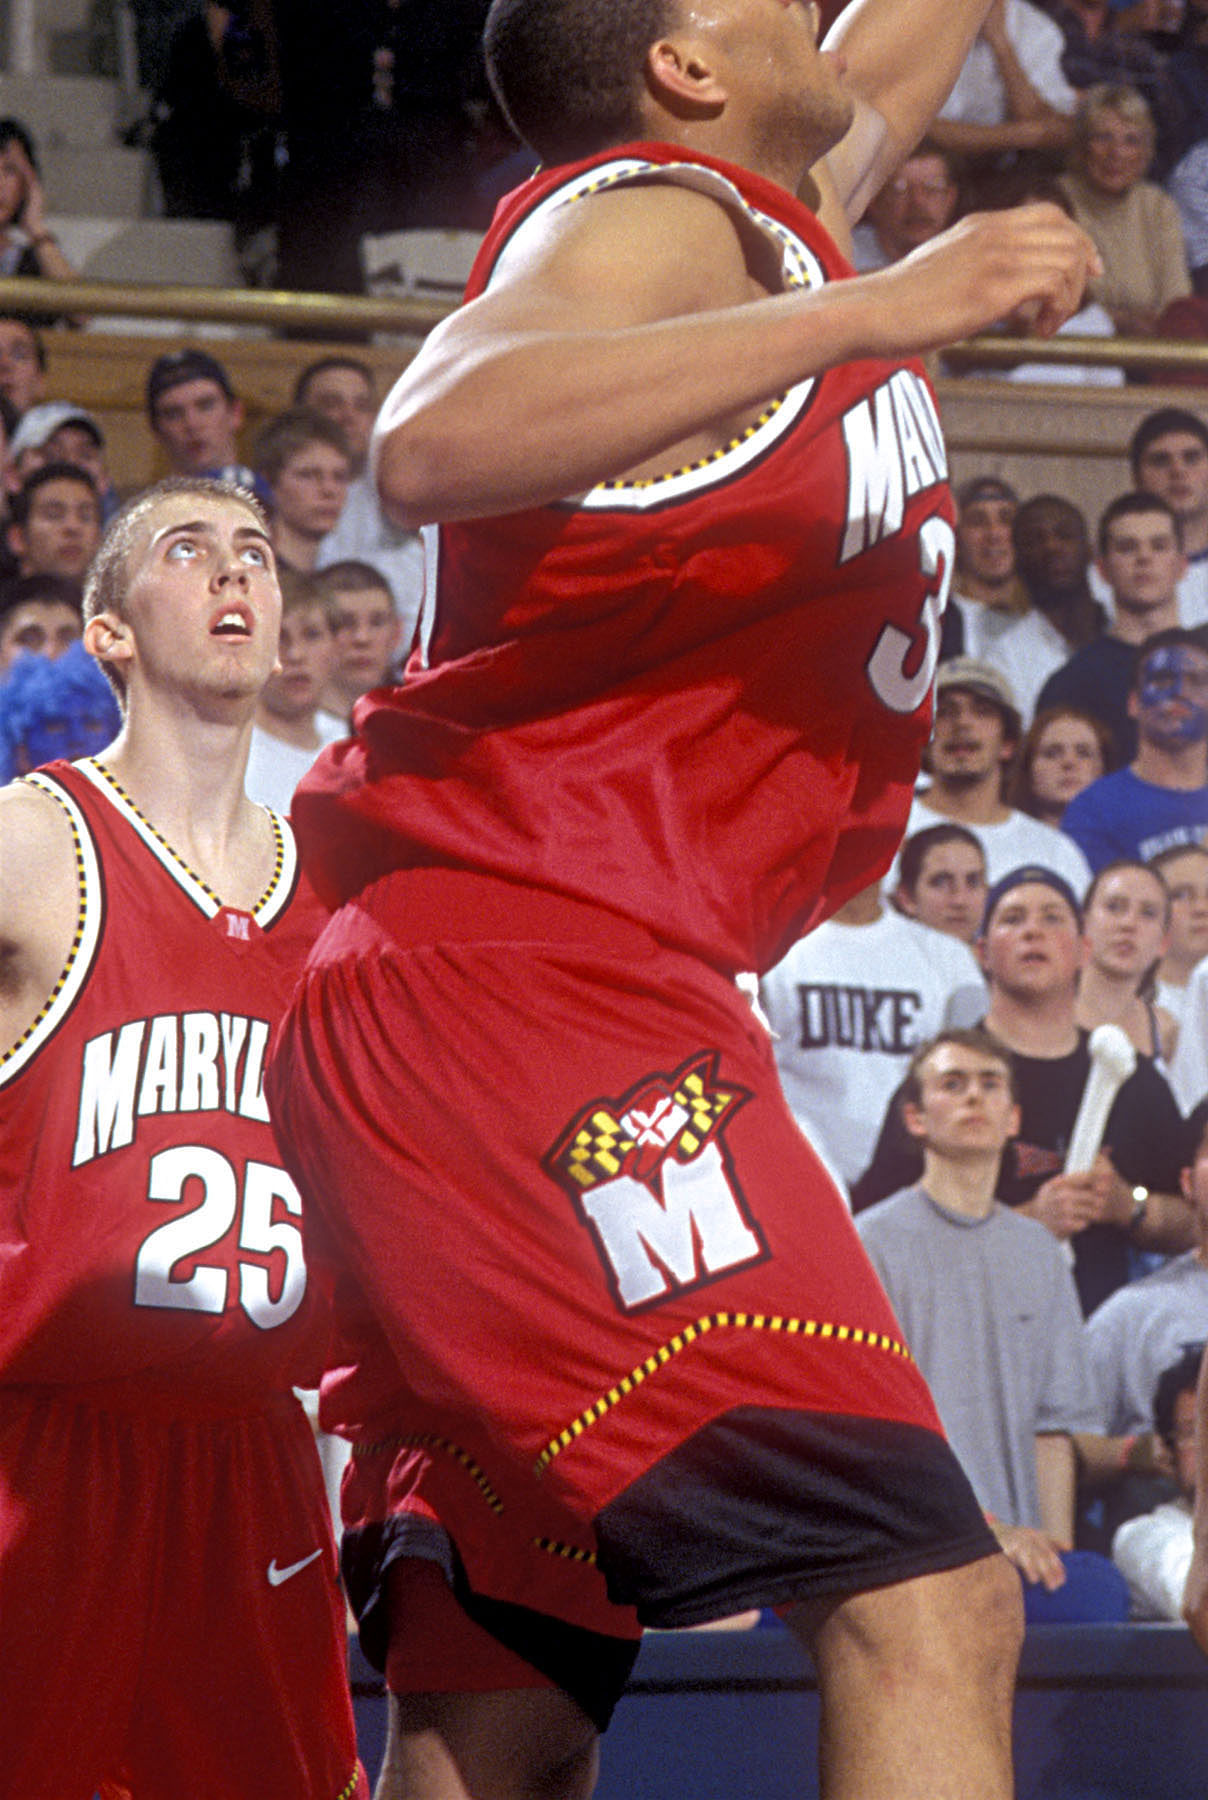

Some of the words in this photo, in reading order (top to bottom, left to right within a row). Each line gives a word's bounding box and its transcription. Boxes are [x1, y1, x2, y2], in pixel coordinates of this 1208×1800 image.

[868, 515, 956, 713] 3
[226, 913, 250, 941] M
[71, 1011, 271, 1171] MARYL
[797, 983, 921, 1054] DUKE
[134, 1144, 307, 1330] 25
[581, 1141, 759, 1308] M
